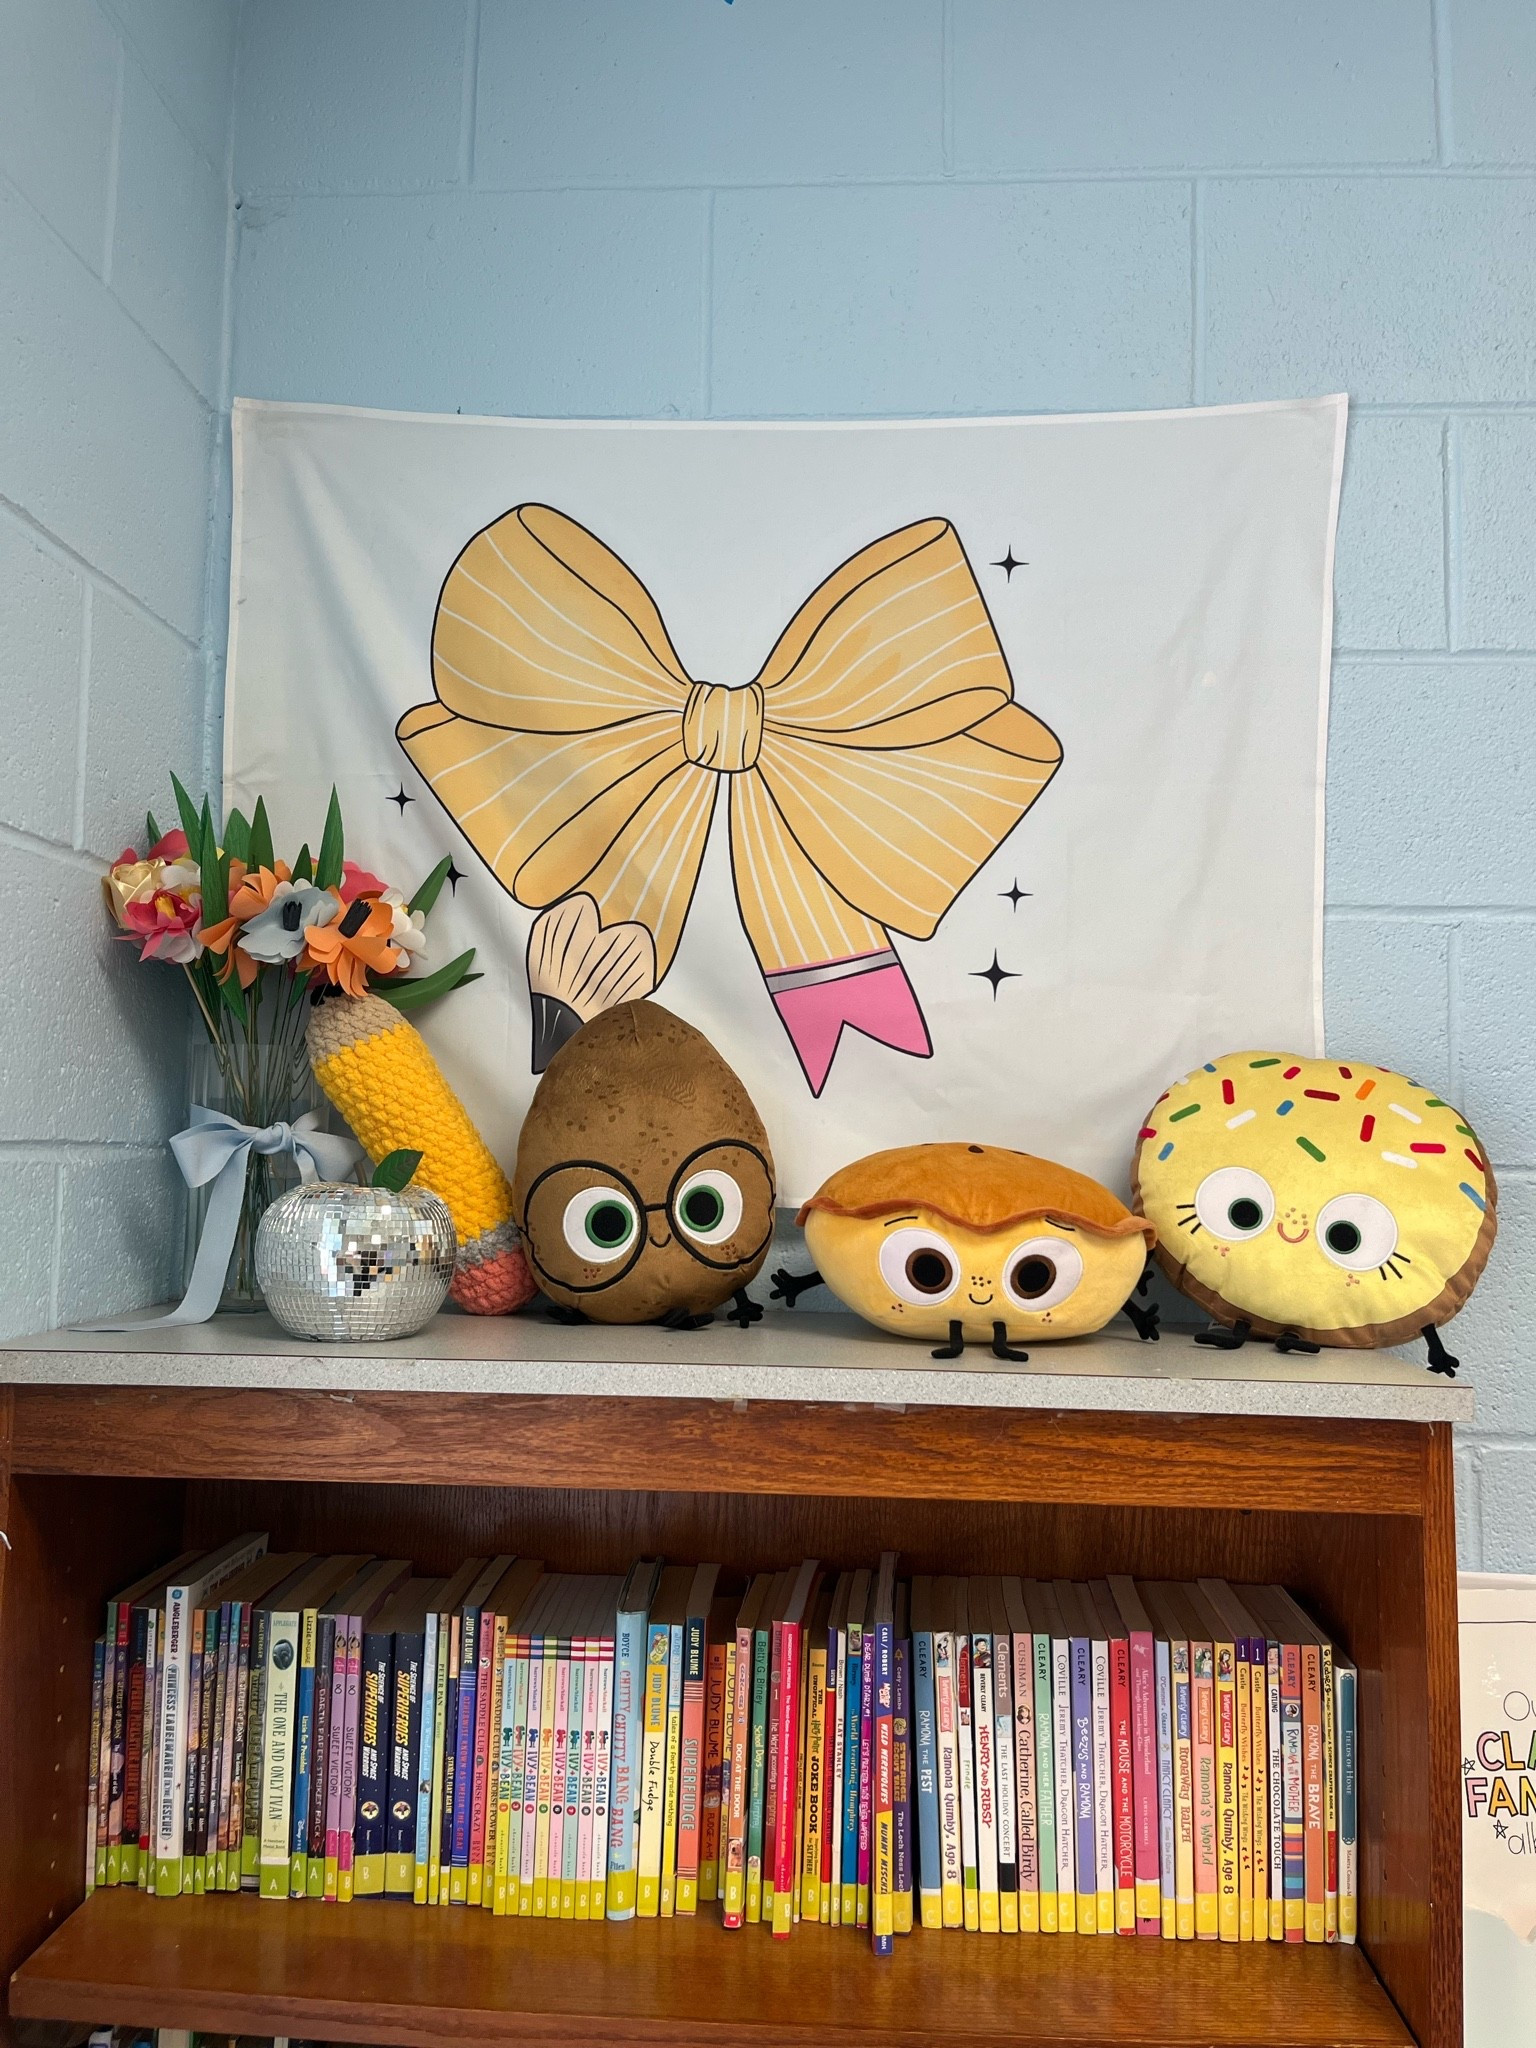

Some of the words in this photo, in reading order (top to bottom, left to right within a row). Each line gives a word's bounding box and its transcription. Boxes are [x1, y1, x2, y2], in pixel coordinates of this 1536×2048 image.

[170, 1602, 182, 1653] ANGLEBERGER
[466, 1617, 474, 1636] JUDY
[691, 1627, 699, 1646] JUDY
[464, 1638, 473, 1664] BLUME
[621, 1633, 630, 1658] BOYCE
[690, 1650, 699, 1675] BLUME
[756, 1642, 766, 1662] Betty
[918, 1641, 928, 1678] CLEARY
[1038, 1643, 1047, 1680] CLEARY
[652, 1672, 661, 1694] JUDY
[756, 1666, 766, 1674] G.
[960, 1650, 968, 1693] Clements
[998, 1642, 1009, 1698] Clements
[1018, 1642, 1027, 1696] CUSHMAN
[1077, 1648, 1086, 1685] CLEARY
[1117, 1649, 1126, 1687] CLEARY
[1287, 1652, 1296, 1688] CLEARY
[1307, 1654, 1316, 1692] CLEARY
[272, 1692, 288, 1713] THE
[619, 1670, 630, 1712] CHITTY
[710, 1679, 721, 1712] JUDY
[755, 1678, 765, 1704] Birney
[363, 1671, 378, 1746] SUPERHEROES
[395, 1671, 410, 1746] SUPERHEROES
[479, 1693, 488, 1726] SADDLE
[650, 1698, 660, 1726] BLUME
[272, 1717, 286, 1736] ONE
[332, 1726, 340, 1754] SWEET
[345, 1727, 354, 1754] SWEET
[477, 1728, 486, 1752] CLUB
[614, 1714, 626, 1762] CHITTY
[708, 1719, 720, 1758] BLUME
[754, 1725, 762, 1748] School
[850, 1715, 858, 1740] World
[880, 1724, 888, 1744] WILD
[918, 1710, 930, 1745] RAMONA
[1038, 1713, 1050, 1748] RAMONA
[1308, 1725, 1319, 1760] RAMONA
[272, 1740, 285, 1761] AND
[300, 1745, 308, 1774] President
[648, 1742, 660, 1775] Double
[755, 1750, 764, 1768] Days
[770, 1734, 779, 1754] World
[979, 1725, 990, 1768] HENRY
[1118, 1738, 1130, 1774] MOUSE
[1288, 1729, 1300, 1764] RAMONA
[270, 1766, 284, 1790] ONLY
[330, 1760, 338, 1797] VICTORY
[362, 1746, 370, 1777] WARRIORS
[810, 1756, 820, 1790] JOKE
[880, 1750, 888, 1804] WEREWOLVES
[944, 1747, 953, 1788] Ramona
[1018, 1730, 1032, 1798] Catherine,
[344, 1761, 352, 1798] VICTORY
[476, 1772, 484, 1801] HORSE
[490, 1778, 498, 1807] HORSE
[616, 1766, 630, 1805] BANG
[642, 1780, 658, 1811] Fudge
[682, 1738, 698, 1830] SUPERFUDGE
[922, 1768, 932, 1793] PEST
[1200, 1757, 1212, 1816] Ramona's
[1223, 1762, 1233, 1804] Ramona
[1288, 1778, 1300, 1812] MOTHER
[270, 1796, 282, 1820] IVAN
[752, 1800, 760, 1829] Humphrey
[809, 1795, 818, 1834] BOOK
[944, 1794, 956, 1838] Quimby,
[980, 1787, 992, 1828] RIBSY
[1040, 1790, 1052, 1825] FATHER
[1079, 1783, 1092, 1818] RAMONA
[1162, 1790, 1172, 1820] CLANCY
[1272, 1772, 1281, 1832] CHOCOLATE
[1309, 1784, 1320, 1830] BRAVE
[474, 1805, 482, 1832] CRAZY
[488, 1810, 497, 1840] POWER
[610, 1807, 624, 1848] BANG
[1020, 1801, 1034, 1840] Called
[1222, 1808, 1234, 1854] Quimby,
[946, 1844, 956, 1865] Age
[1120, 1816, 1132, 1876] MOTORCYCLE
[1202, 1824, 1213, 1865] World
[1274, 1836, 1282, 1869] TOUCH
[121, 1862, 128, 1873] A
[161, 1866, 168, 1877] A
[185, 1873, 192, 1884] A
[947, 1871, 957, 1879] 8
[1020, 1844, 1035, 1882] Birdy
[1222, 1860, 1234, 1880] Age
[1223, 1886, 1234, 1894] 8
